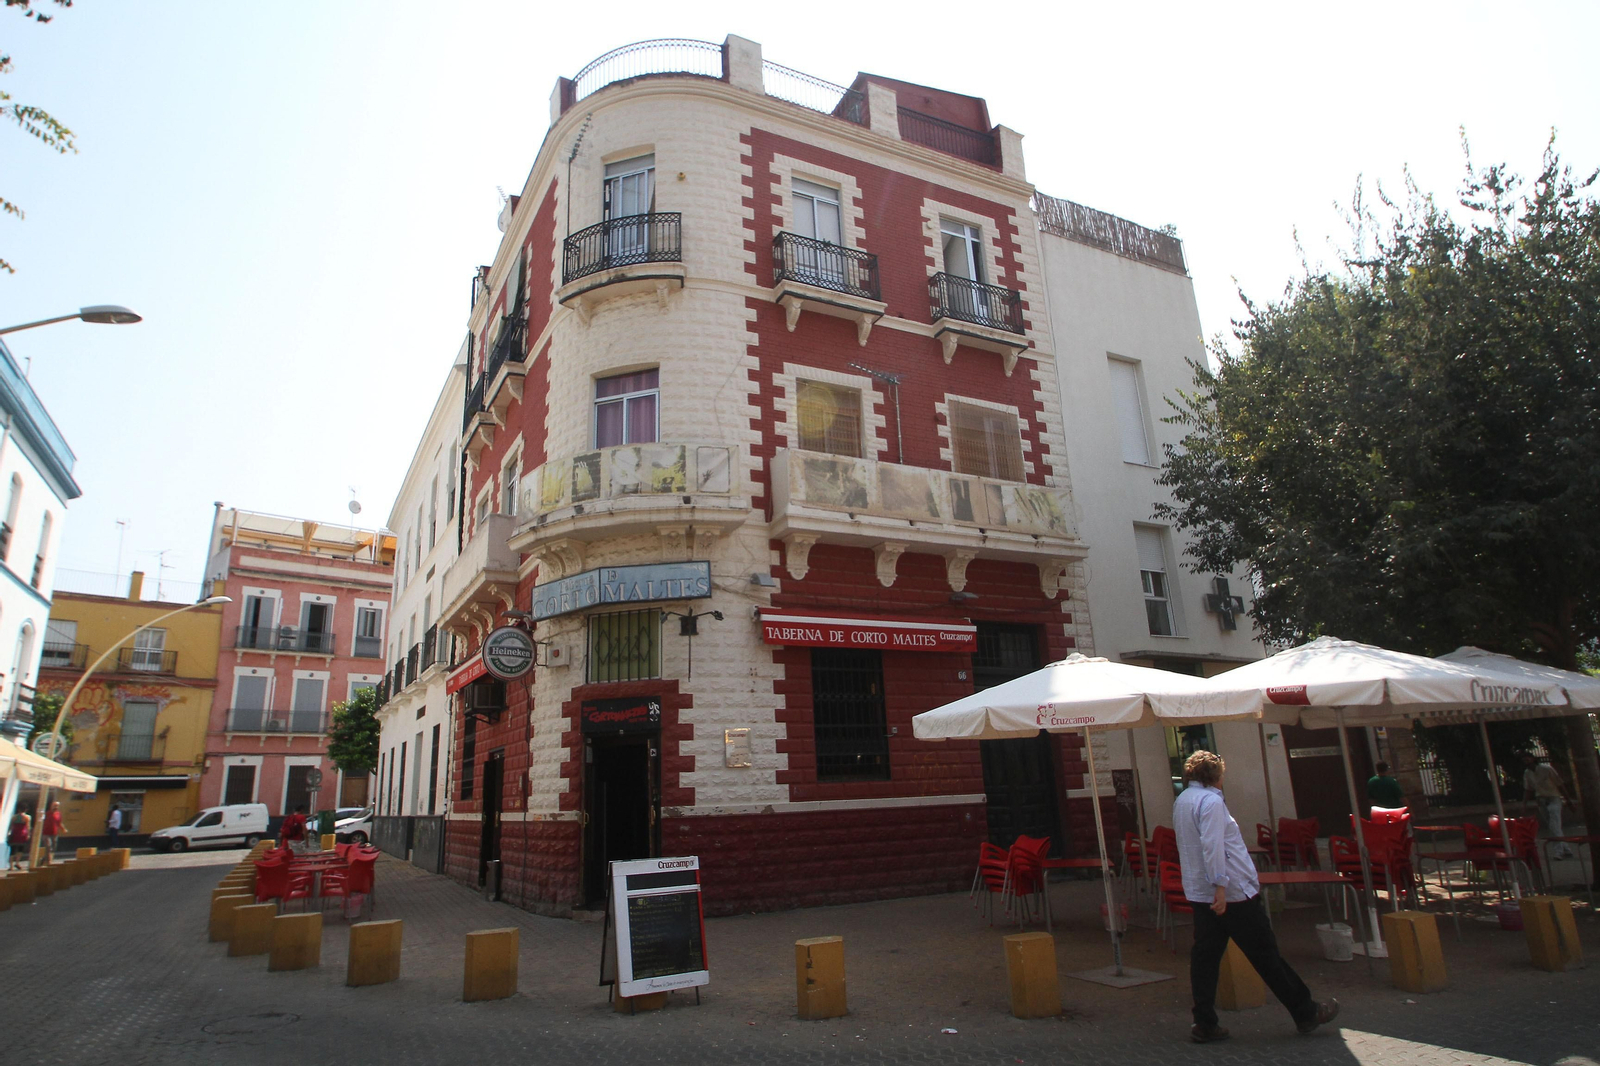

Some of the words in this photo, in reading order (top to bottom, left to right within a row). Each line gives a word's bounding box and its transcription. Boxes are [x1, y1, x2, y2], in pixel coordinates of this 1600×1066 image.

[558, 574, 594, 594] Taberna
[533, 584, 599, 620] CORTO
[603, 577, 709, 602] MALTES
[765, 626, 824, 642] TABERNA
[829, 630, 845, 643] DE
[851, 631, 888, 645] CORTO
[893, 633, 937, 647] MALTES
[939, 631, 973, 643] Cruzcampo
[491, 647, 531, 658] Heineken
[958, 671, 967, 681] 66
[1051, 715, 1095, 726] Cruzcampo
[657, 859, 694, 870] Cruzcampo
